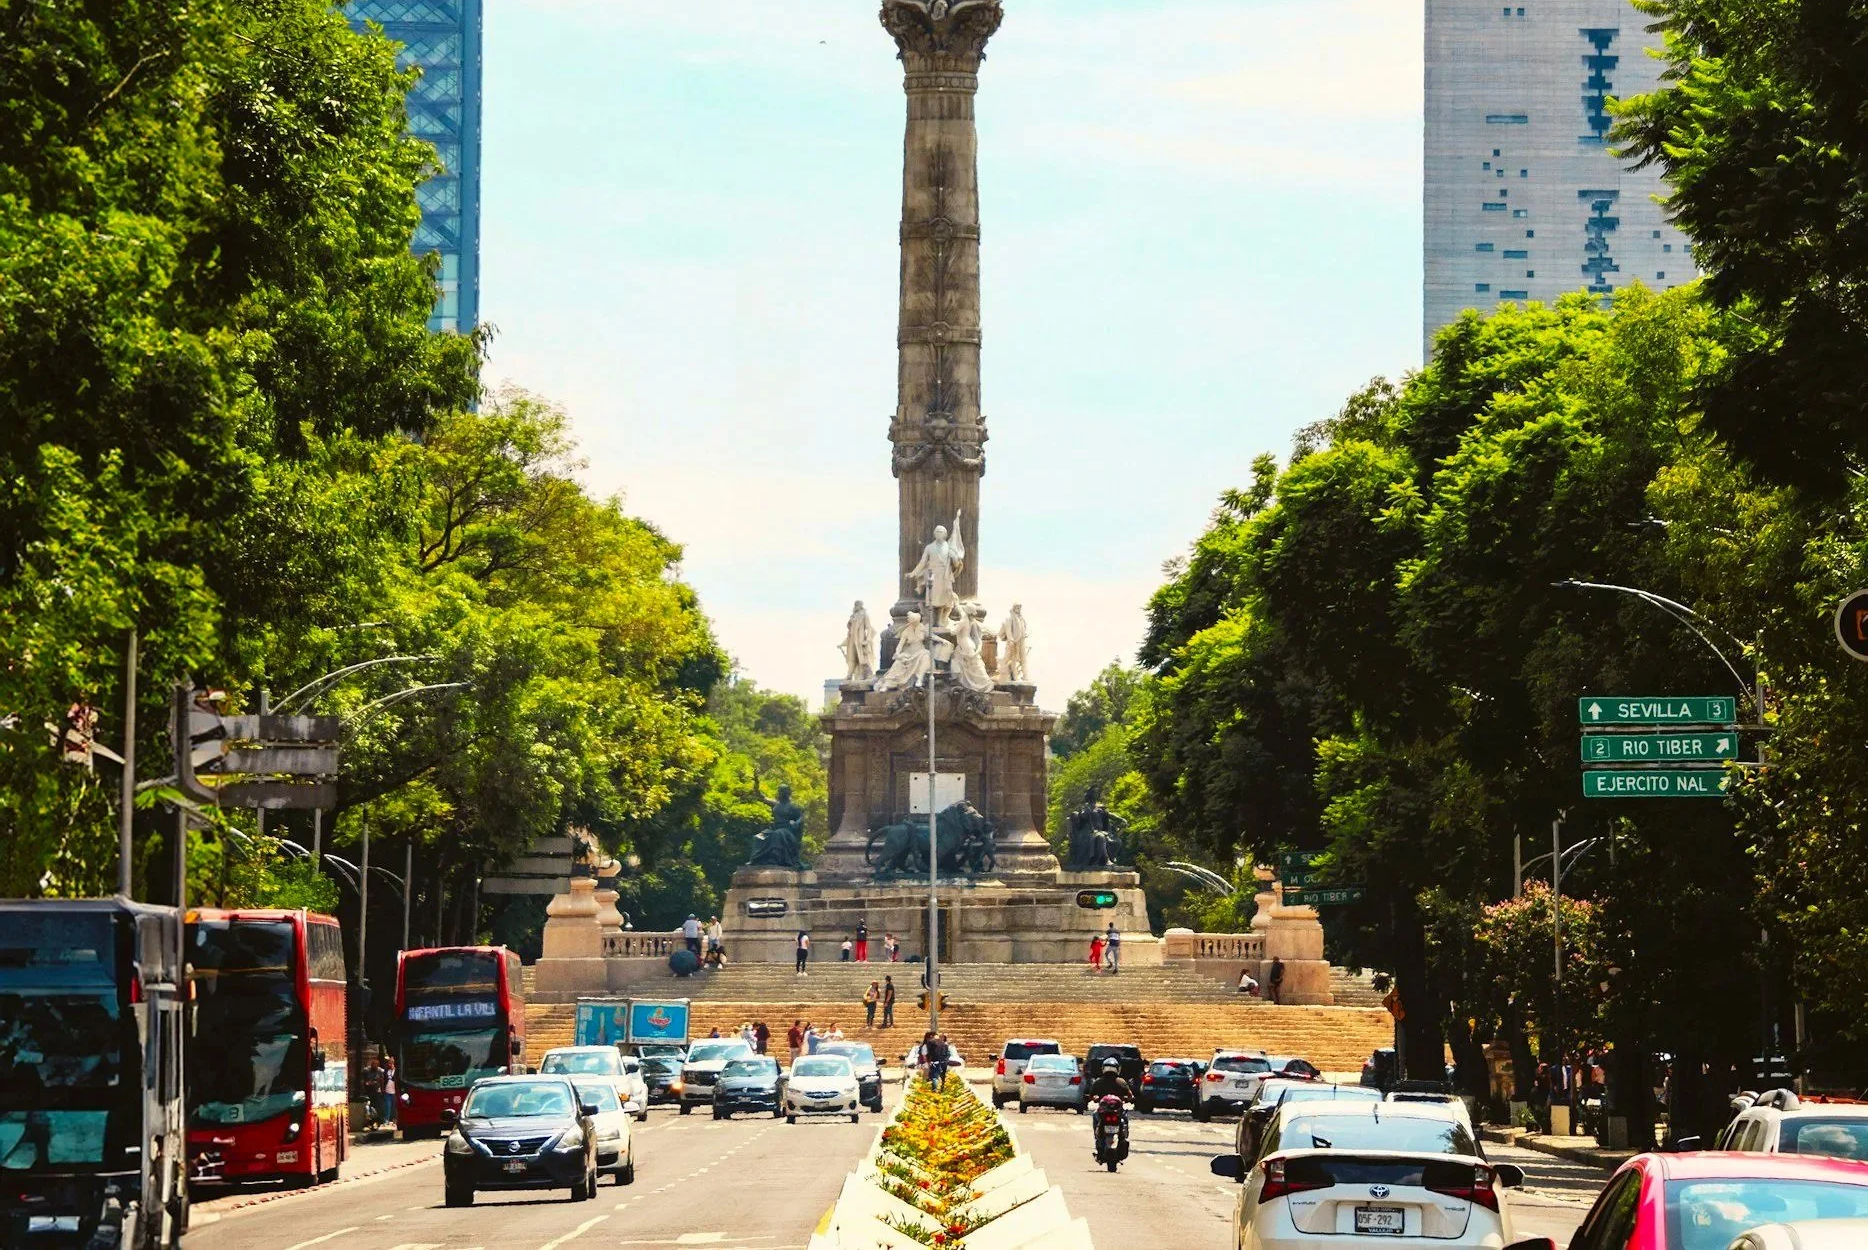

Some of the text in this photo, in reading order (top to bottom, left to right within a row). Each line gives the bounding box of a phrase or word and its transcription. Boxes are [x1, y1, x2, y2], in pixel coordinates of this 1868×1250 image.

[1618, 703, 1722, 718] SEVILLA 3
[1596, 739, 1703, 755] 2 RIO TIBER
[1597, 776, 1708, 792] EJERCITO NAL
[1303, 894, 1319, 903] RIO
[1322, 892, 1348, 902] TIBER
[457, 1003, 472, 1017] LA
